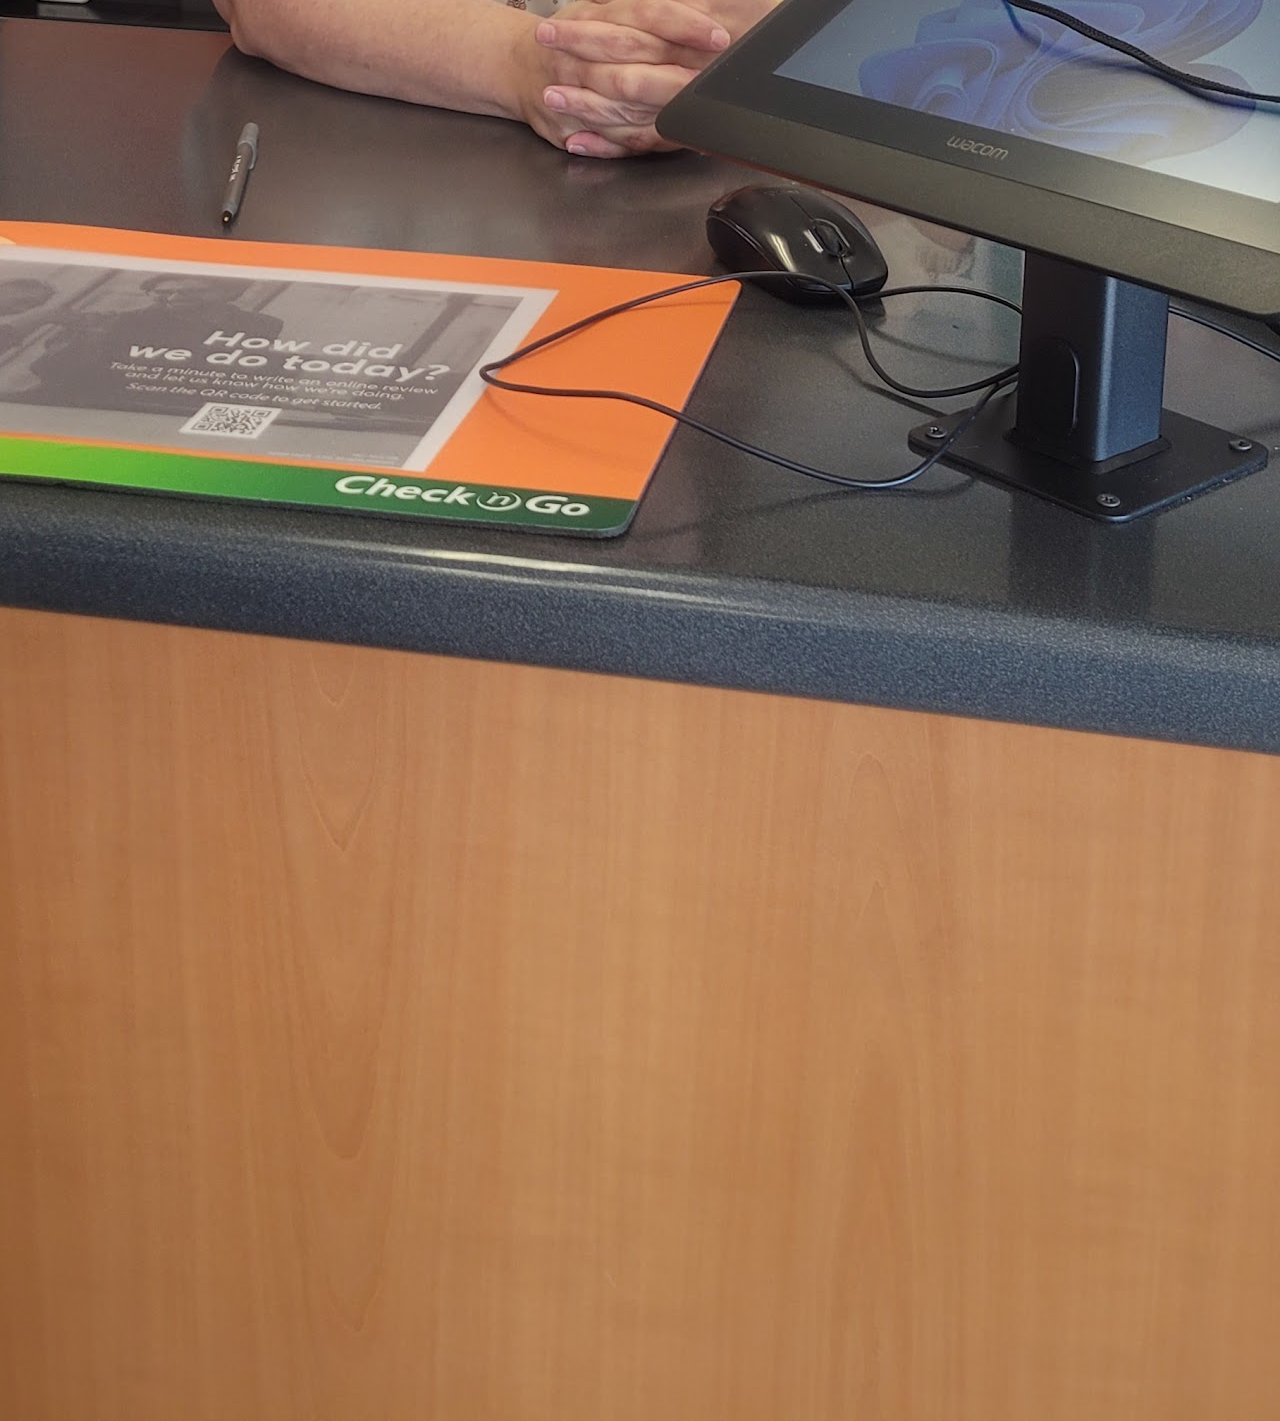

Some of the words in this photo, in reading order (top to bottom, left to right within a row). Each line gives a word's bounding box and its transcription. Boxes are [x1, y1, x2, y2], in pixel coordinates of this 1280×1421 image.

[946, 135, 1009, 160] wacom
[203, 330, 312, 352] How
[322, 339, 403, 360] did
[110, 361, 147, 372] Take
[152, 366, 164, 374] a
[167, 367, 227, 378] minute
[231, 371, 248, 380] to
[253, 374, 295, 384] write
[299, 379, 321, 387] an
[326, 379, 378, 390] online
[382, 383, 439, 394] review
[129, 345, 193, 361] we
[206, 349, 268, 367] do
[283, 355, 450, 383] today?
[125, 371, 162, 380] and
[163, 373, 186, 382] let
[212, 376, 259, 388] know
[262, 381, 299, 391] how
[305, 386, 348, 395] we're
[352, 389, 405, 400] doing.
[126, 382, 167, 392] Scan
[170, 386, 197, 395] the
[200, 388, 229, 398] QR
[229, 392, 270, 402] code
[272, 395, 289, 403] to
[292, 397, 320, 406] get
[322, 398, 382, 411] started.
[334, 475, 476, 506] Check
[525, 495, 591, 517] Go
